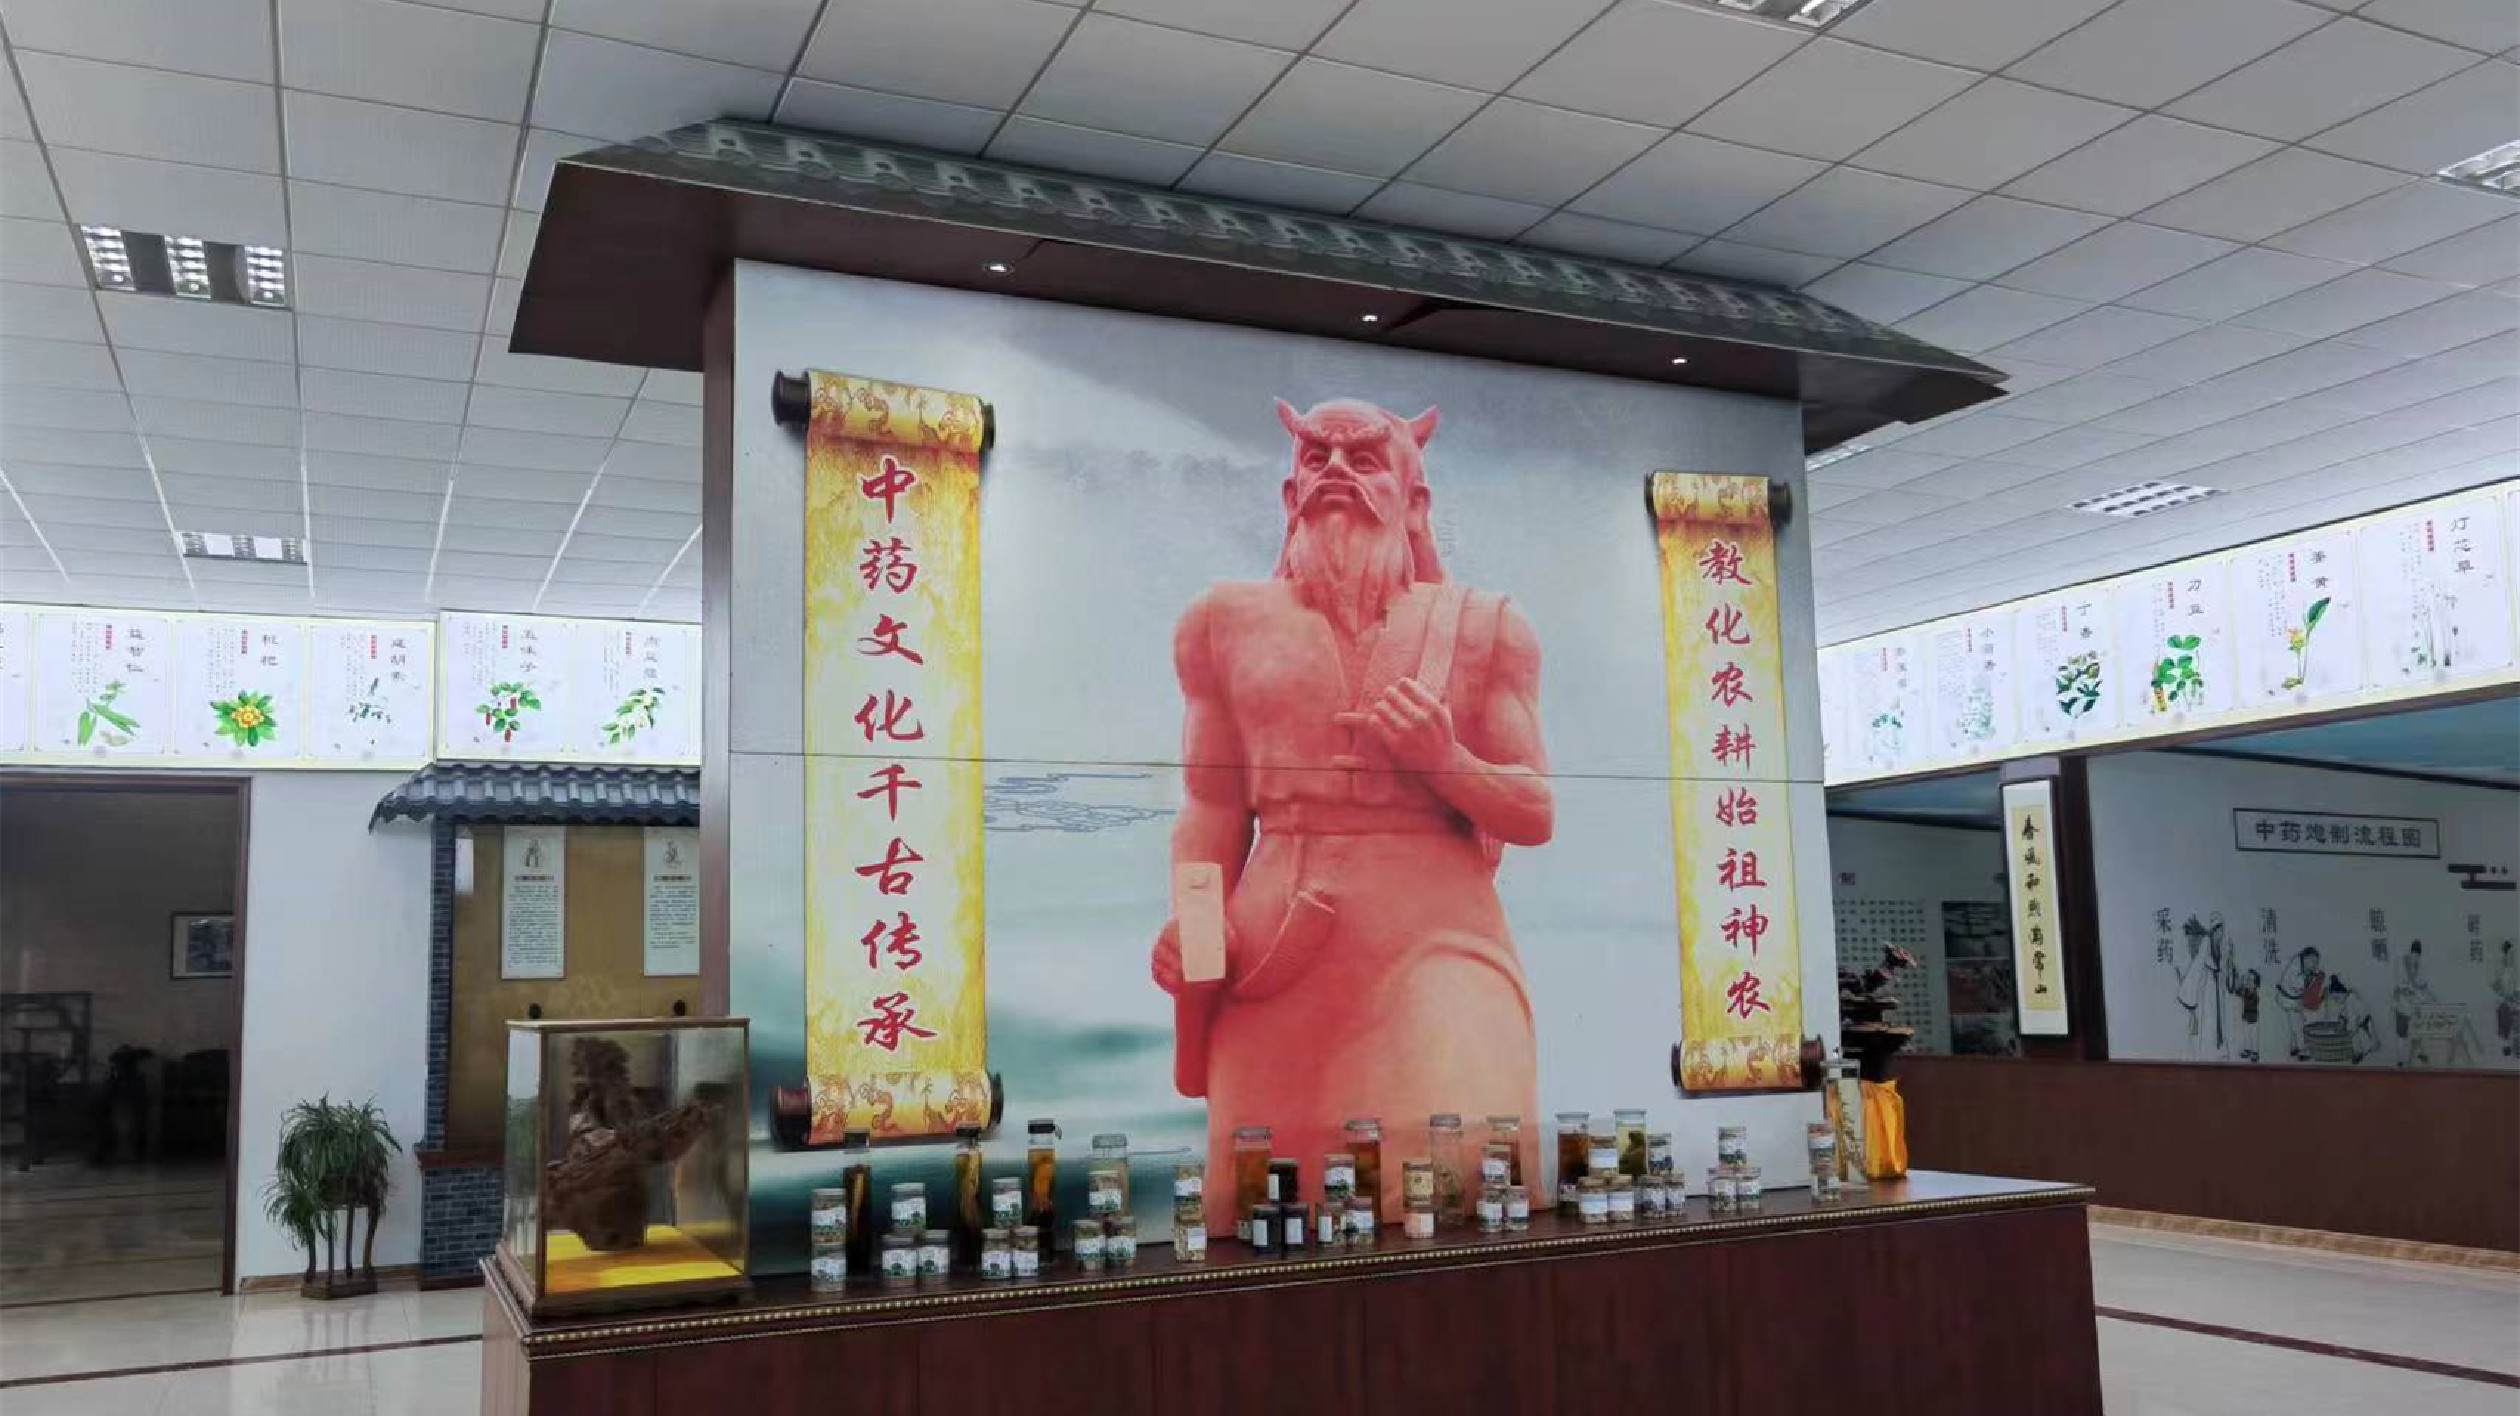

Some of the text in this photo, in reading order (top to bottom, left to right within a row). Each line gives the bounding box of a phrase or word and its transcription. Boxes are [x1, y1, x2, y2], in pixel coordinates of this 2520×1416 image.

[854, 458, 938, 1051] 中药文化千古传承
[1699, 540, 1770, 1020] 教化农耕始祖神农
[2256, 820, 2421, 848] 中药炮制流程图
[2156, 907, 2174, 963] 采药
